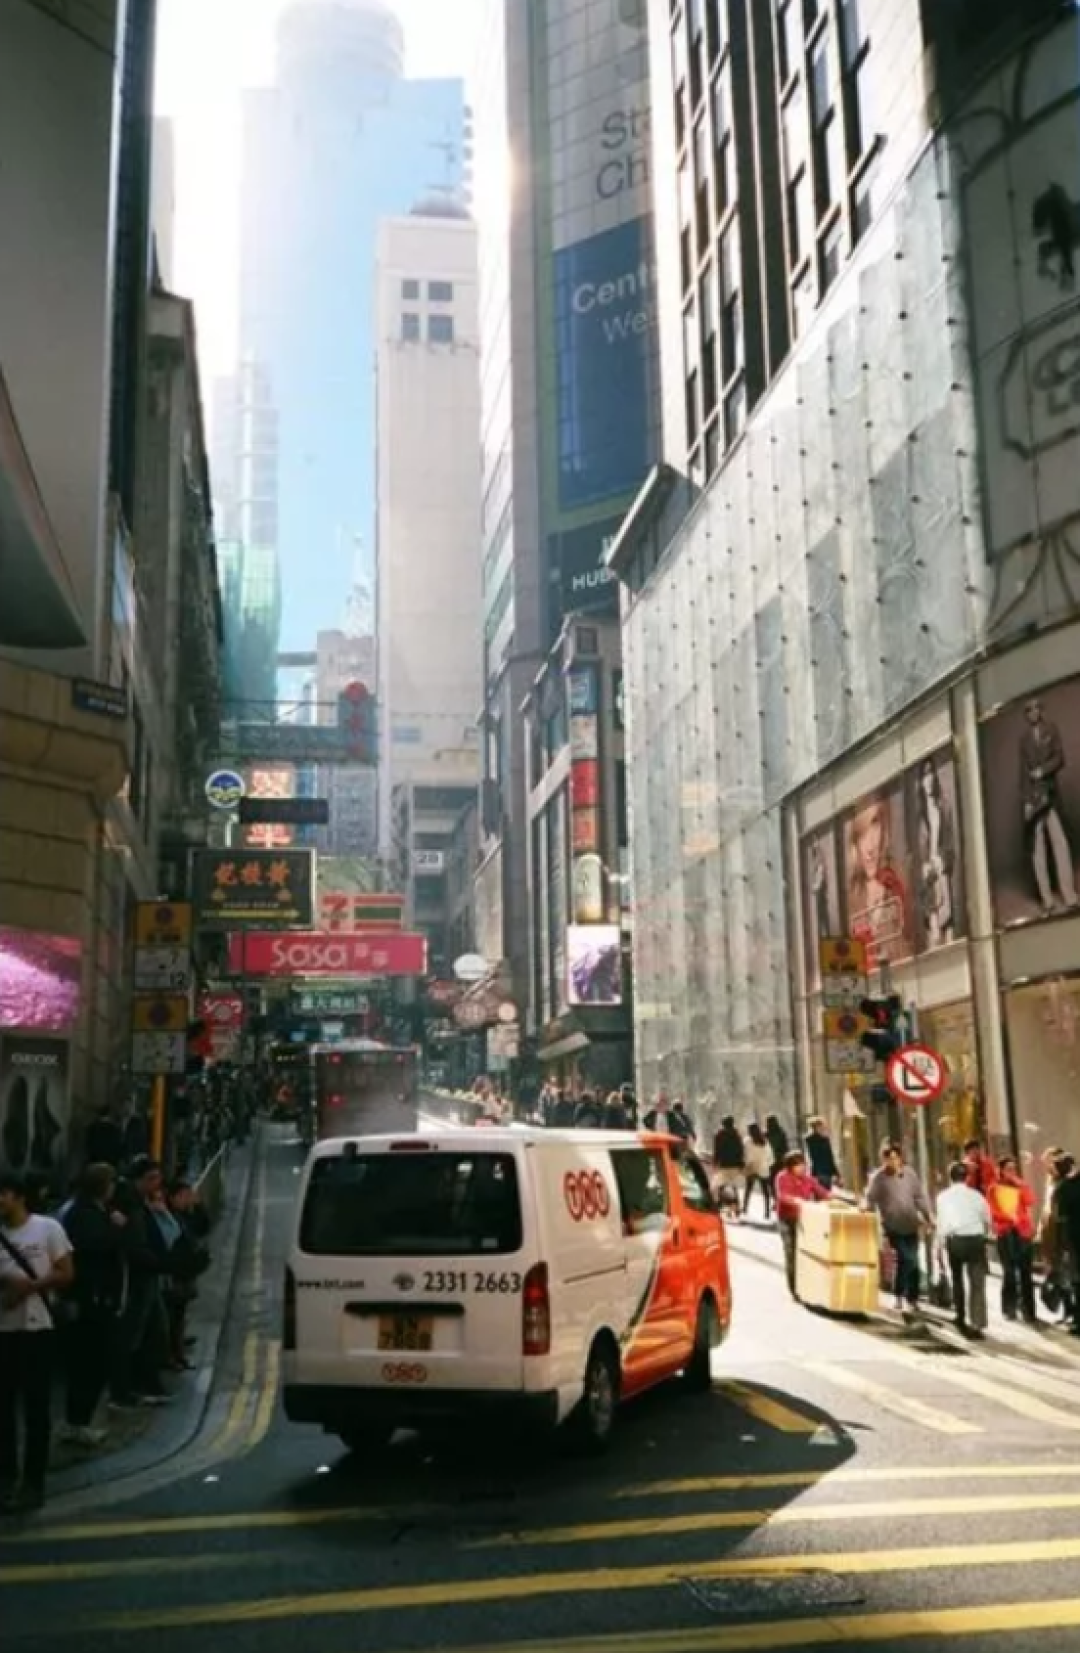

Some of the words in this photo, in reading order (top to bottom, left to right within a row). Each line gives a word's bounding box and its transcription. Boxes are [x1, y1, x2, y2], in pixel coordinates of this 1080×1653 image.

[571, 262, 654, 314] Cent
[322, 893, 349, 930] 7
[423, 1270, 467, 1294] 2331
[473, 1270, 522, 1294] 2663
